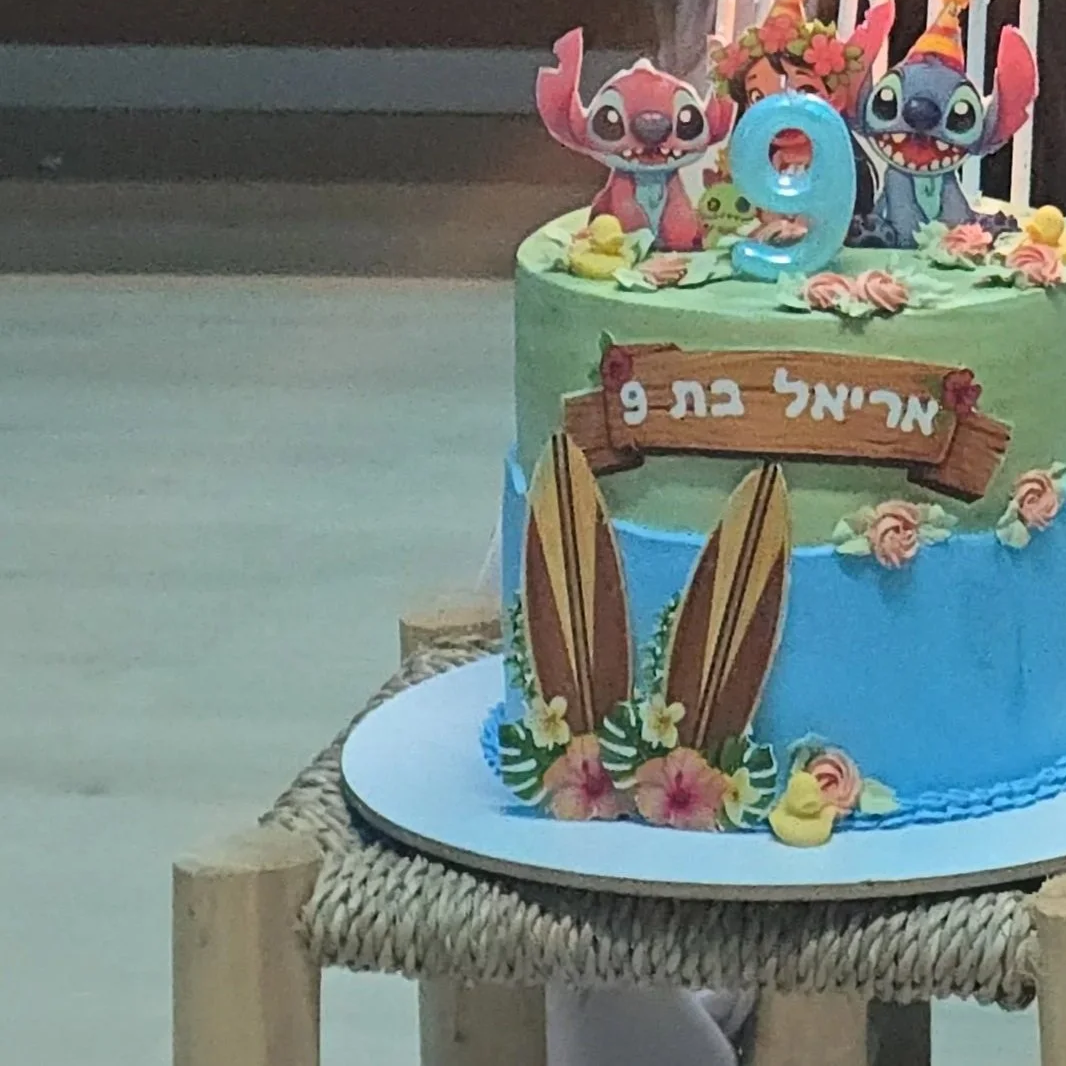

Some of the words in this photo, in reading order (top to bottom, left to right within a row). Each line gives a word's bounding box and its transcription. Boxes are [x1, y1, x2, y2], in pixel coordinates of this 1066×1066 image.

[729, 90, 857, 282] 9
[621, 381, 648, 425] 9
[670, 379, 744, 419] בת
[773, 368, 939, 435] אריאל
